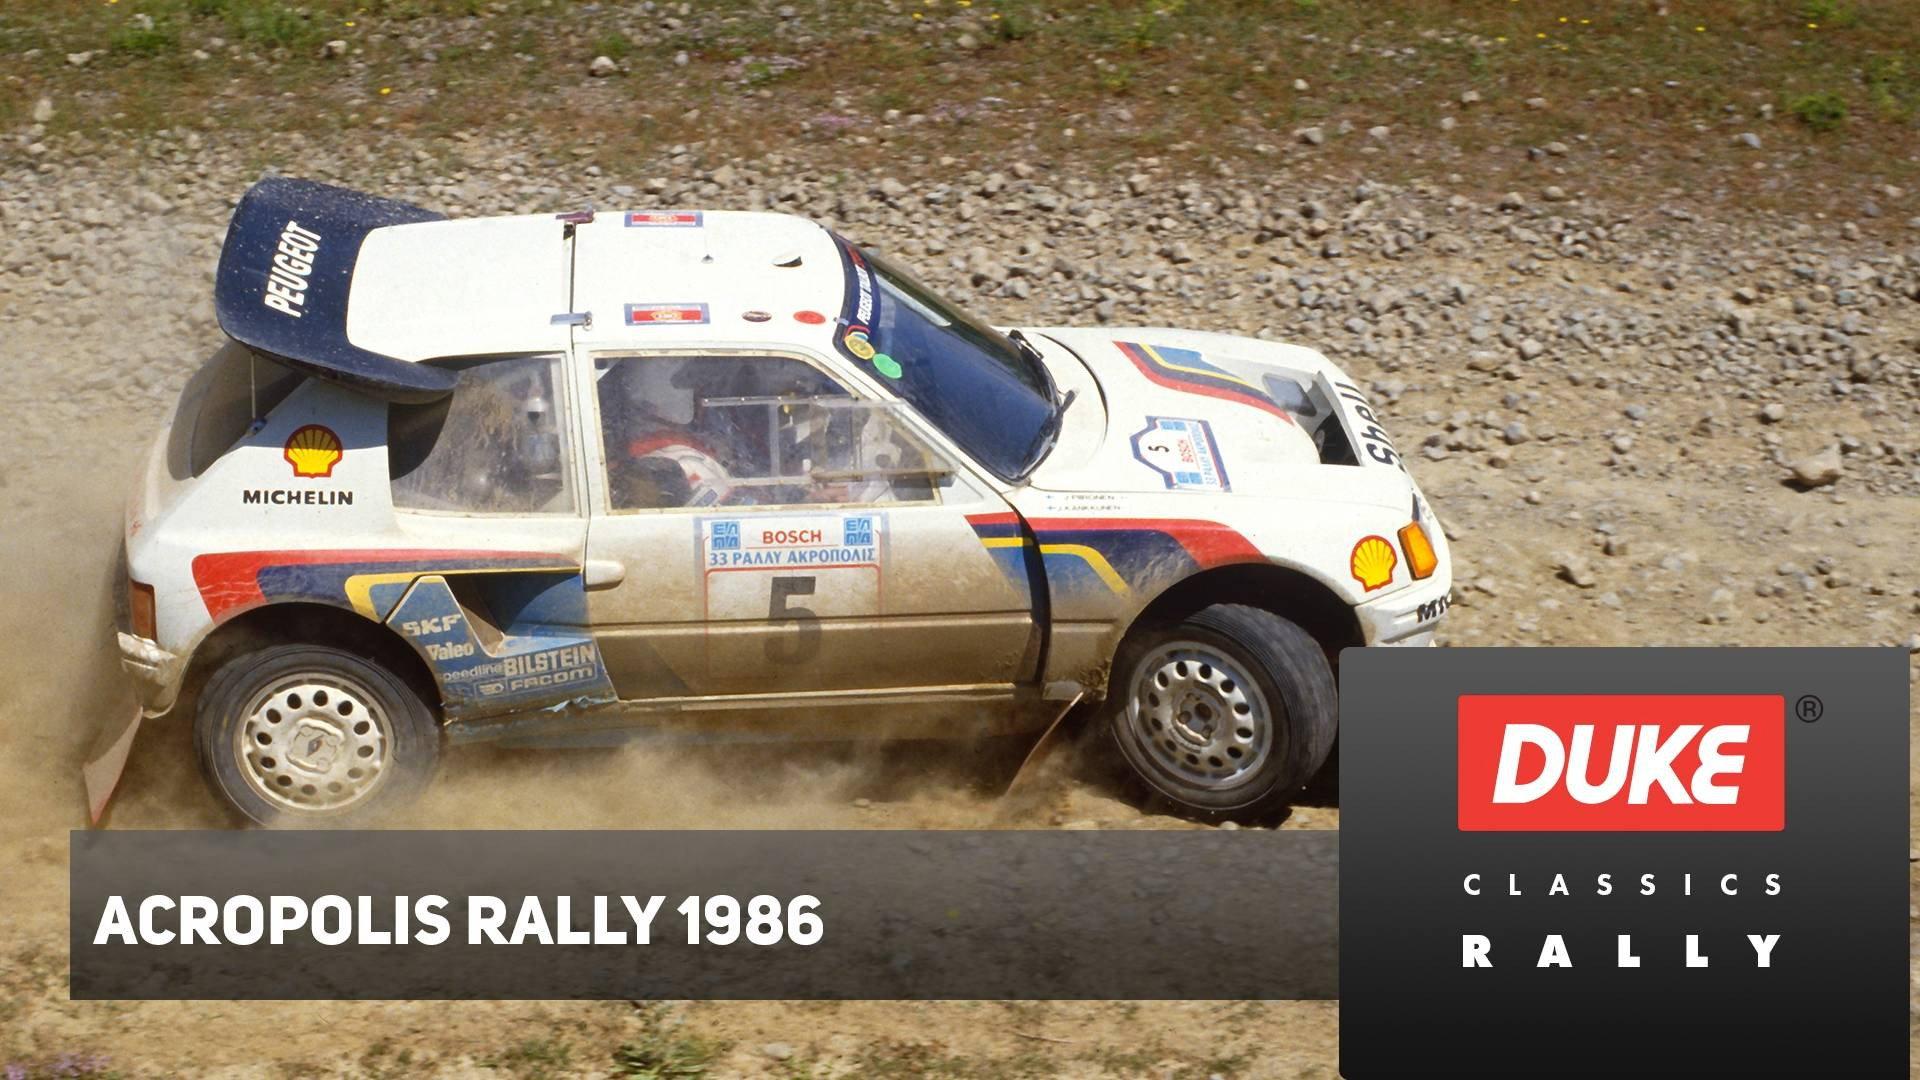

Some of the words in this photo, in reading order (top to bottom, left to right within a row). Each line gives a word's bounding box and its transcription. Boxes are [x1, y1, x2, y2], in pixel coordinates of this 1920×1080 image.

[264, 220, 322, 318] PEUGEOT
[1336, 382, 1400, 466] Shell
[1147, 444, 1170, 453] 5
[243, 489, 353, 506] MICHELIN
[762, 529, 822, 545] BOSCH
[709, 552, 728, 566] 33
[402, 614, 462, 637] SKF
[763, 576, 823, 666] 5
[425, 642, 475, 661] Valeo
[504, 644, 596, 677] BILSTEIN
